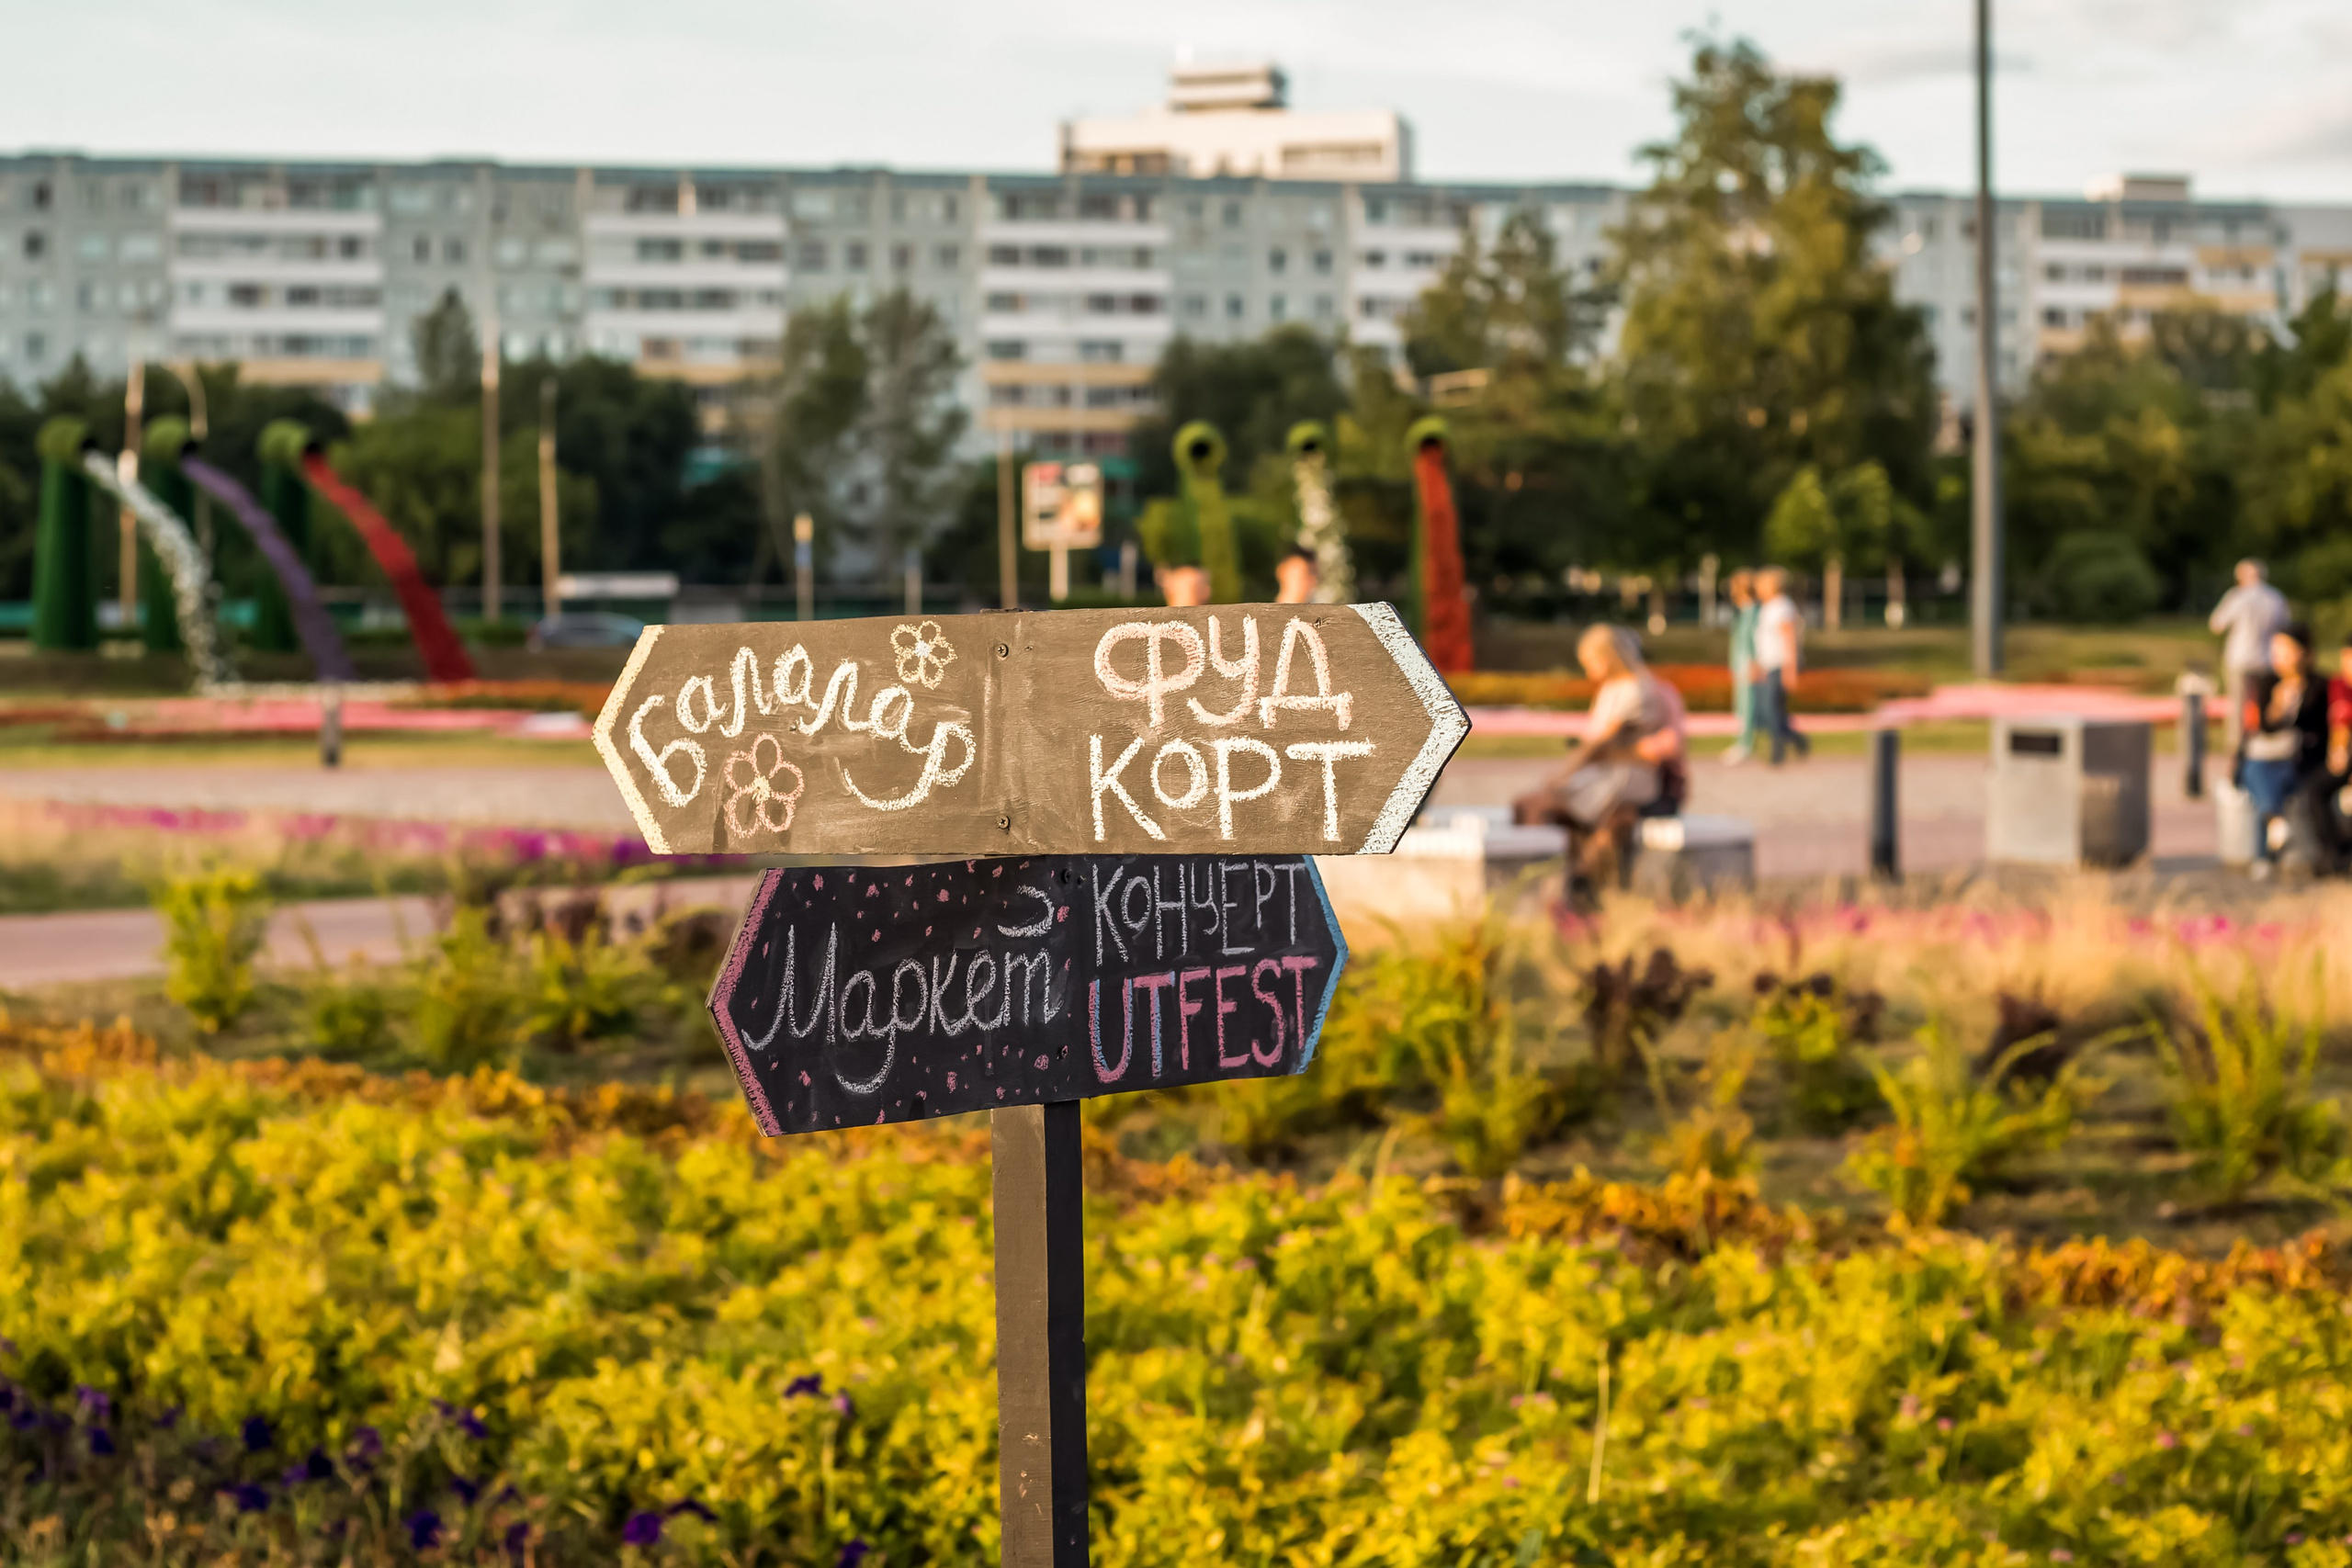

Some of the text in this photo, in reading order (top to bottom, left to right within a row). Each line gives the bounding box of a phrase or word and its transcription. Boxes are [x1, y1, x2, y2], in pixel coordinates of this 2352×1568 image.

[1093, 614, 1354, 734] ФУД
[1090, 733, 1377, 842] КОРТ
[1091, 859, 1308, 967] КОНЦЕРТ
[741, 921, 1067, 1095] Маркет
[1088, 956, 1318, 1085] UTFEST
